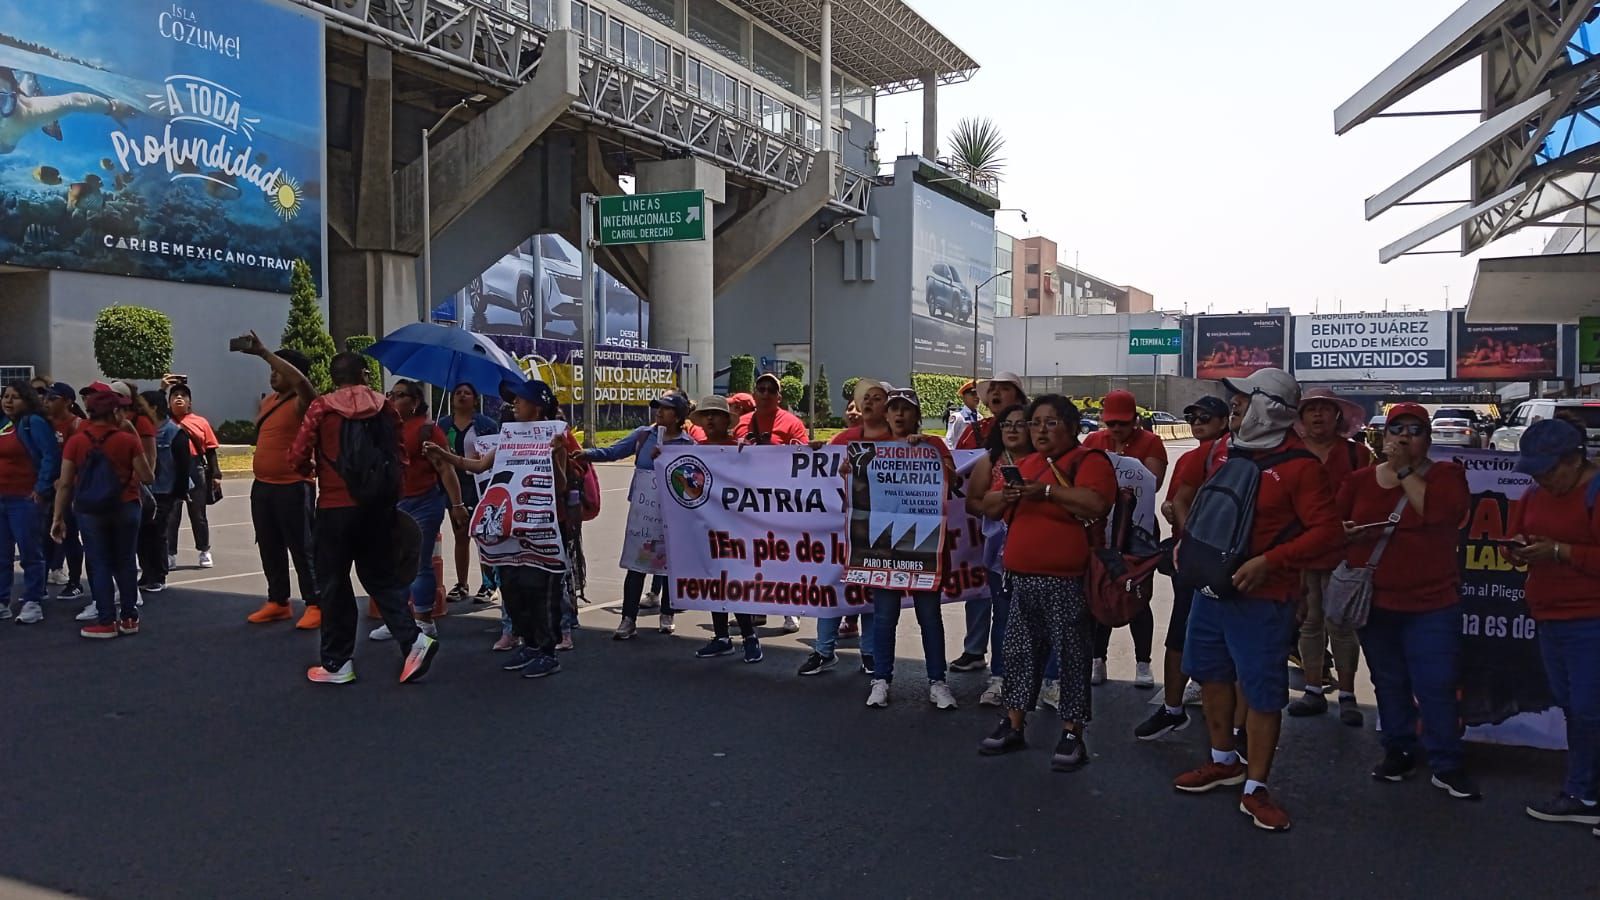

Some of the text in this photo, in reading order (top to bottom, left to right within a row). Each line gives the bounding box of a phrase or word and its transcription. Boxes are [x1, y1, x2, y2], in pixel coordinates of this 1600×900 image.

[166, 82, 241, 131] A TODA
[111, 123, 283, 197] Profundidad
[622, 198, 661, 212] LINEAS
[603, 211, 682, 227] INTERNACIONALES
[611, 227, 674, 240] CARRIL DERECHO
[1311, 319, 1429, 336] BENITO JUÁREZ
[1140, 337, 1171, 346] TERMINAL 2
[1311, 335, 1429, 349] CIUDAD DE MÉXICO
[573, 349, 673, 363] AEPUERTO INTERNACIONAL
[1311, 352, 1429, 367] BIENVENIDOS
[574, 363, 673, 384] BNITO JUÁREZ
[573, 385, 667, 400] CIDAD DE MÉXIC
[876, 446, 937, 459] EXIGIMOS
[871, 460, 941, 471] INCREMENTO
[877, 472, 940, 484] SALARIAL
[721, 487, 827, 513] PATRIA
[753, 531, 791, 567] pie
[796, 532, 826, 563] de
[863, 558, 924, 570] PARO DE LABORES
[676, 570, 839, 608] revalorización
[1478, 584, 1488, 597] al
[1491, 584, 1526, 602] Pliego
[1484, 615, 1508, 639] es
[1512, 613, 1536, 640] de
